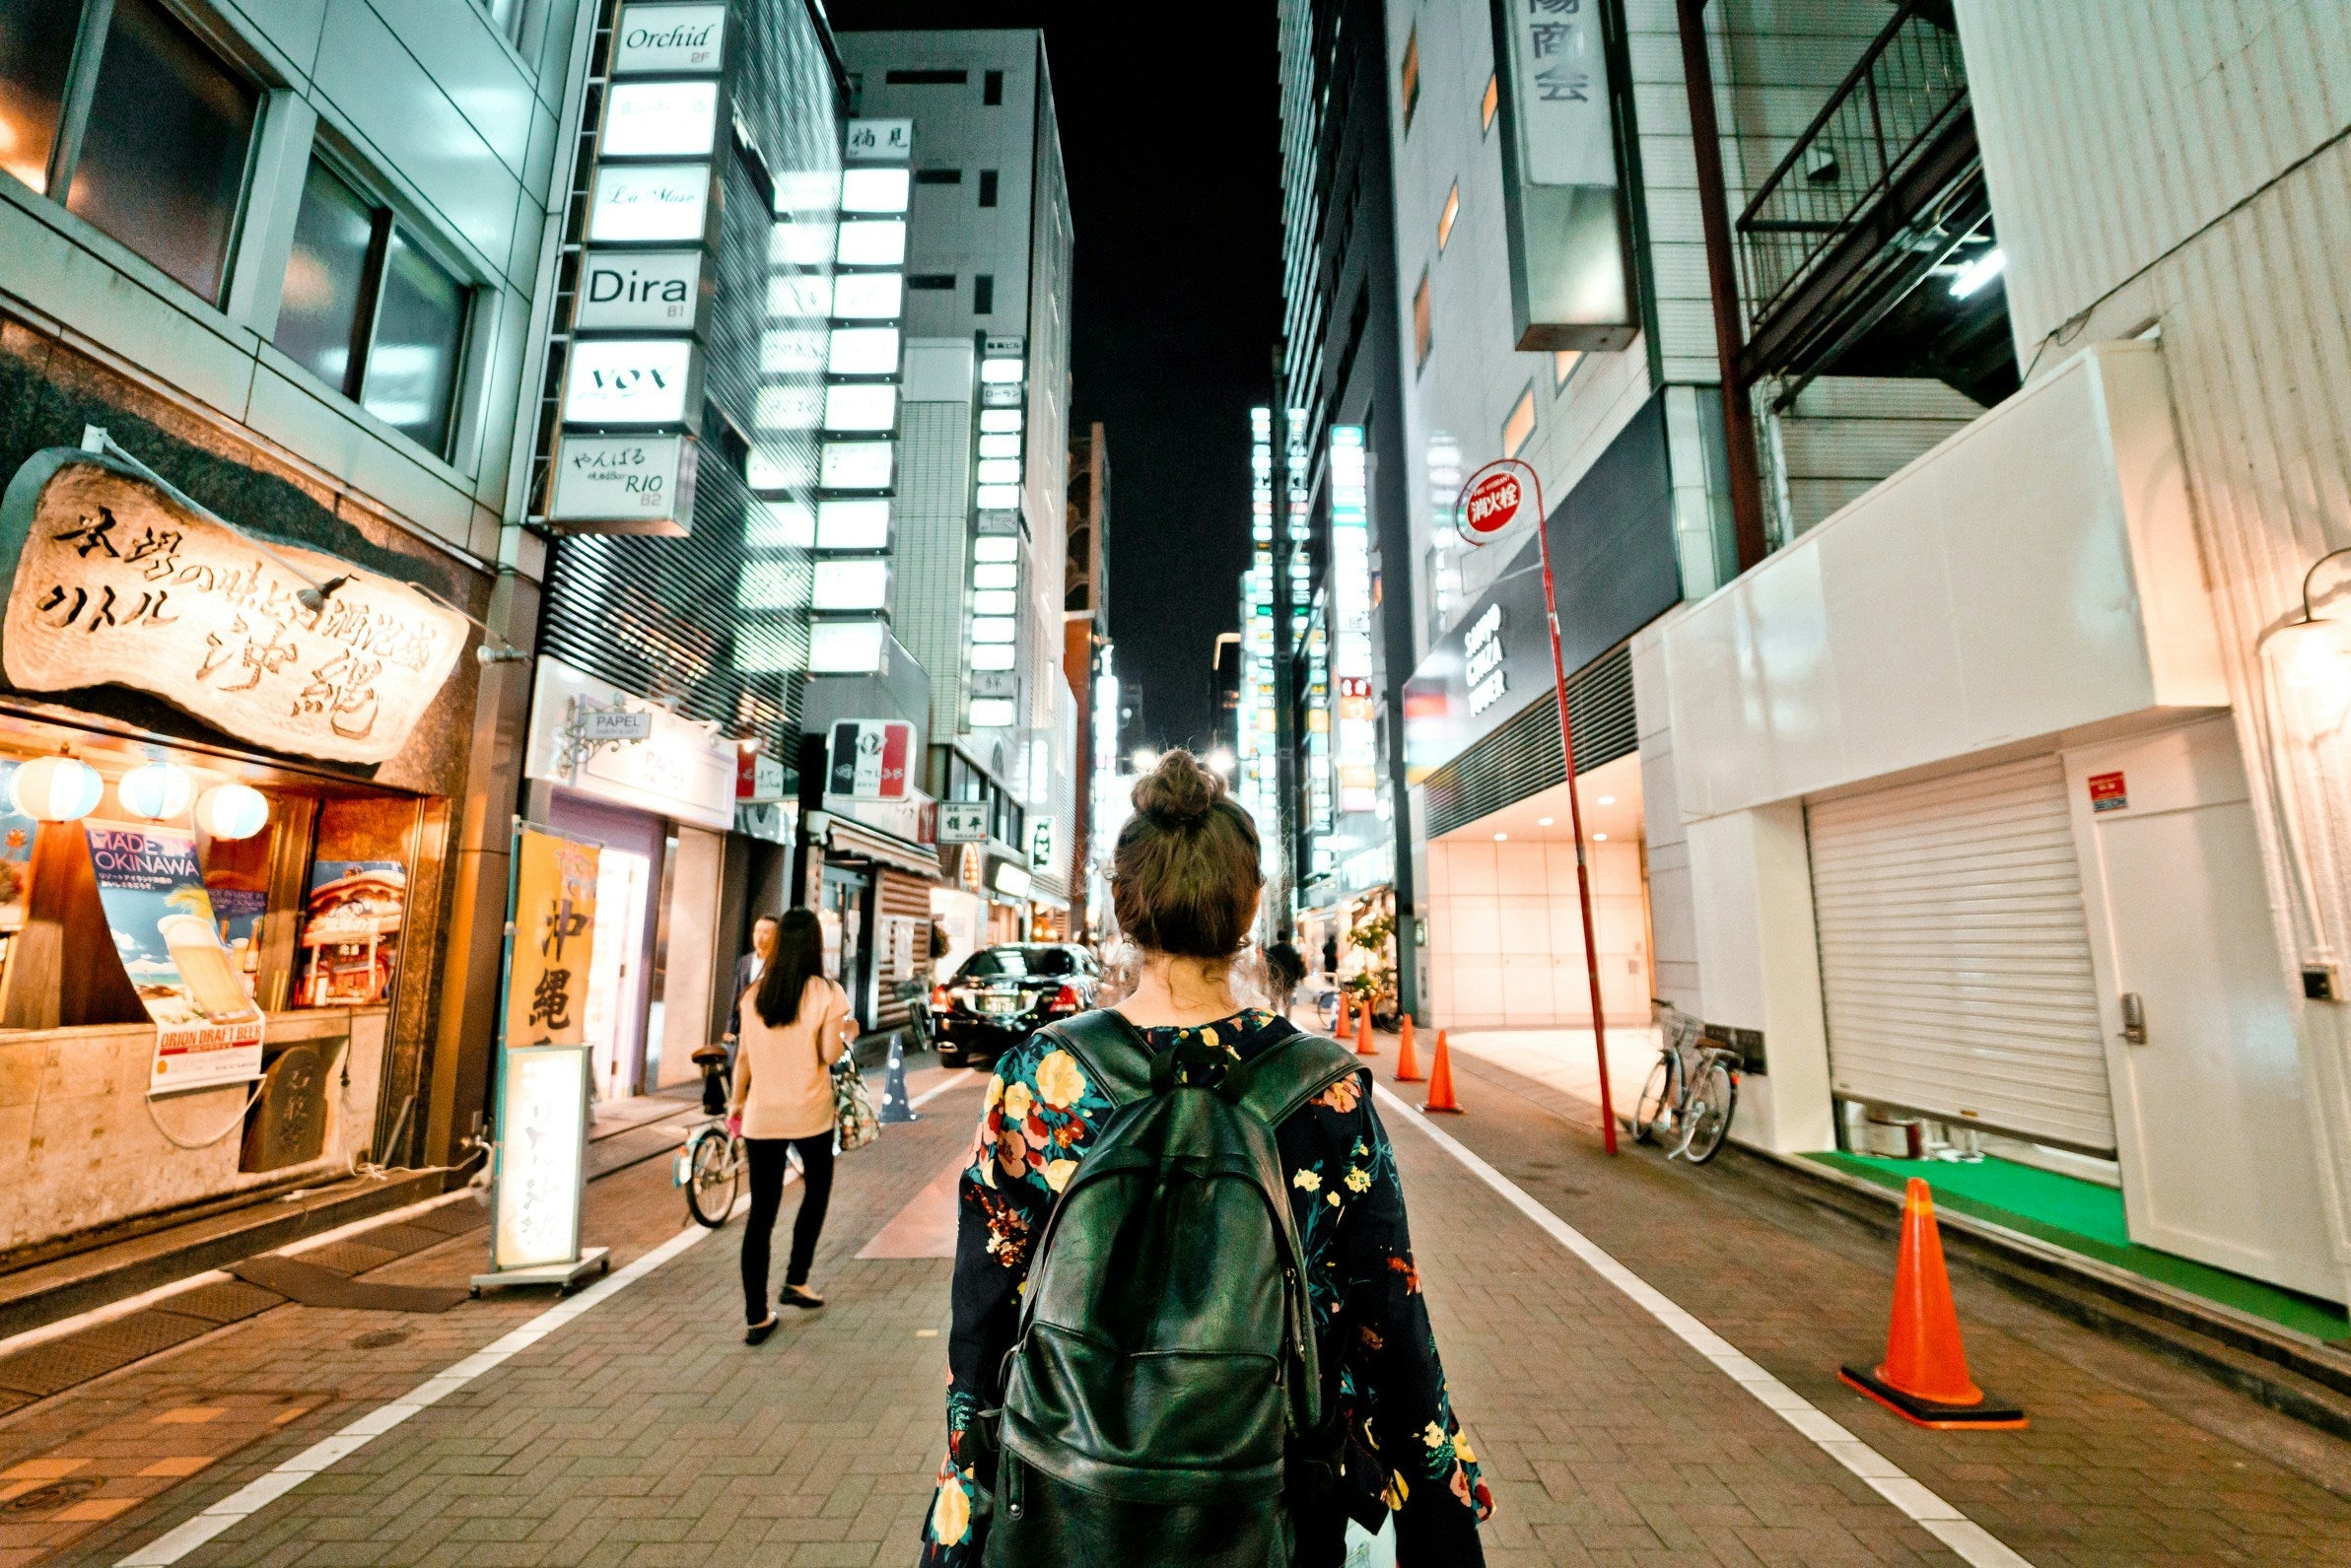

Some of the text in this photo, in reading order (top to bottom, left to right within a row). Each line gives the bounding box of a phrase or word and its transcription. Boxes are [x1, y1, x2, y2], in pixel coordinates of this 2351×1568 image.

[625, 25, 711, 49] Orchid
[588, 268, 688, 304] Dira
[666, 305, 685, 318] B1
[591, 365, 674, 391] VOX
[572, 446, 647, 469] やんばる
[641, 493, 662, 507] B2
[1470, 482, 1519, 523] 消火栓
[596, 715, 641, 727] PAPEL
[95, 850, 200, 877] OKINAWA
[529, 899, 588, 1046] 沖縄
[161, 1031, 197, 1048] ORION
[199, 1027, 234, 1044] DRAFT
[237, 1024, 262, 1040] BEER
